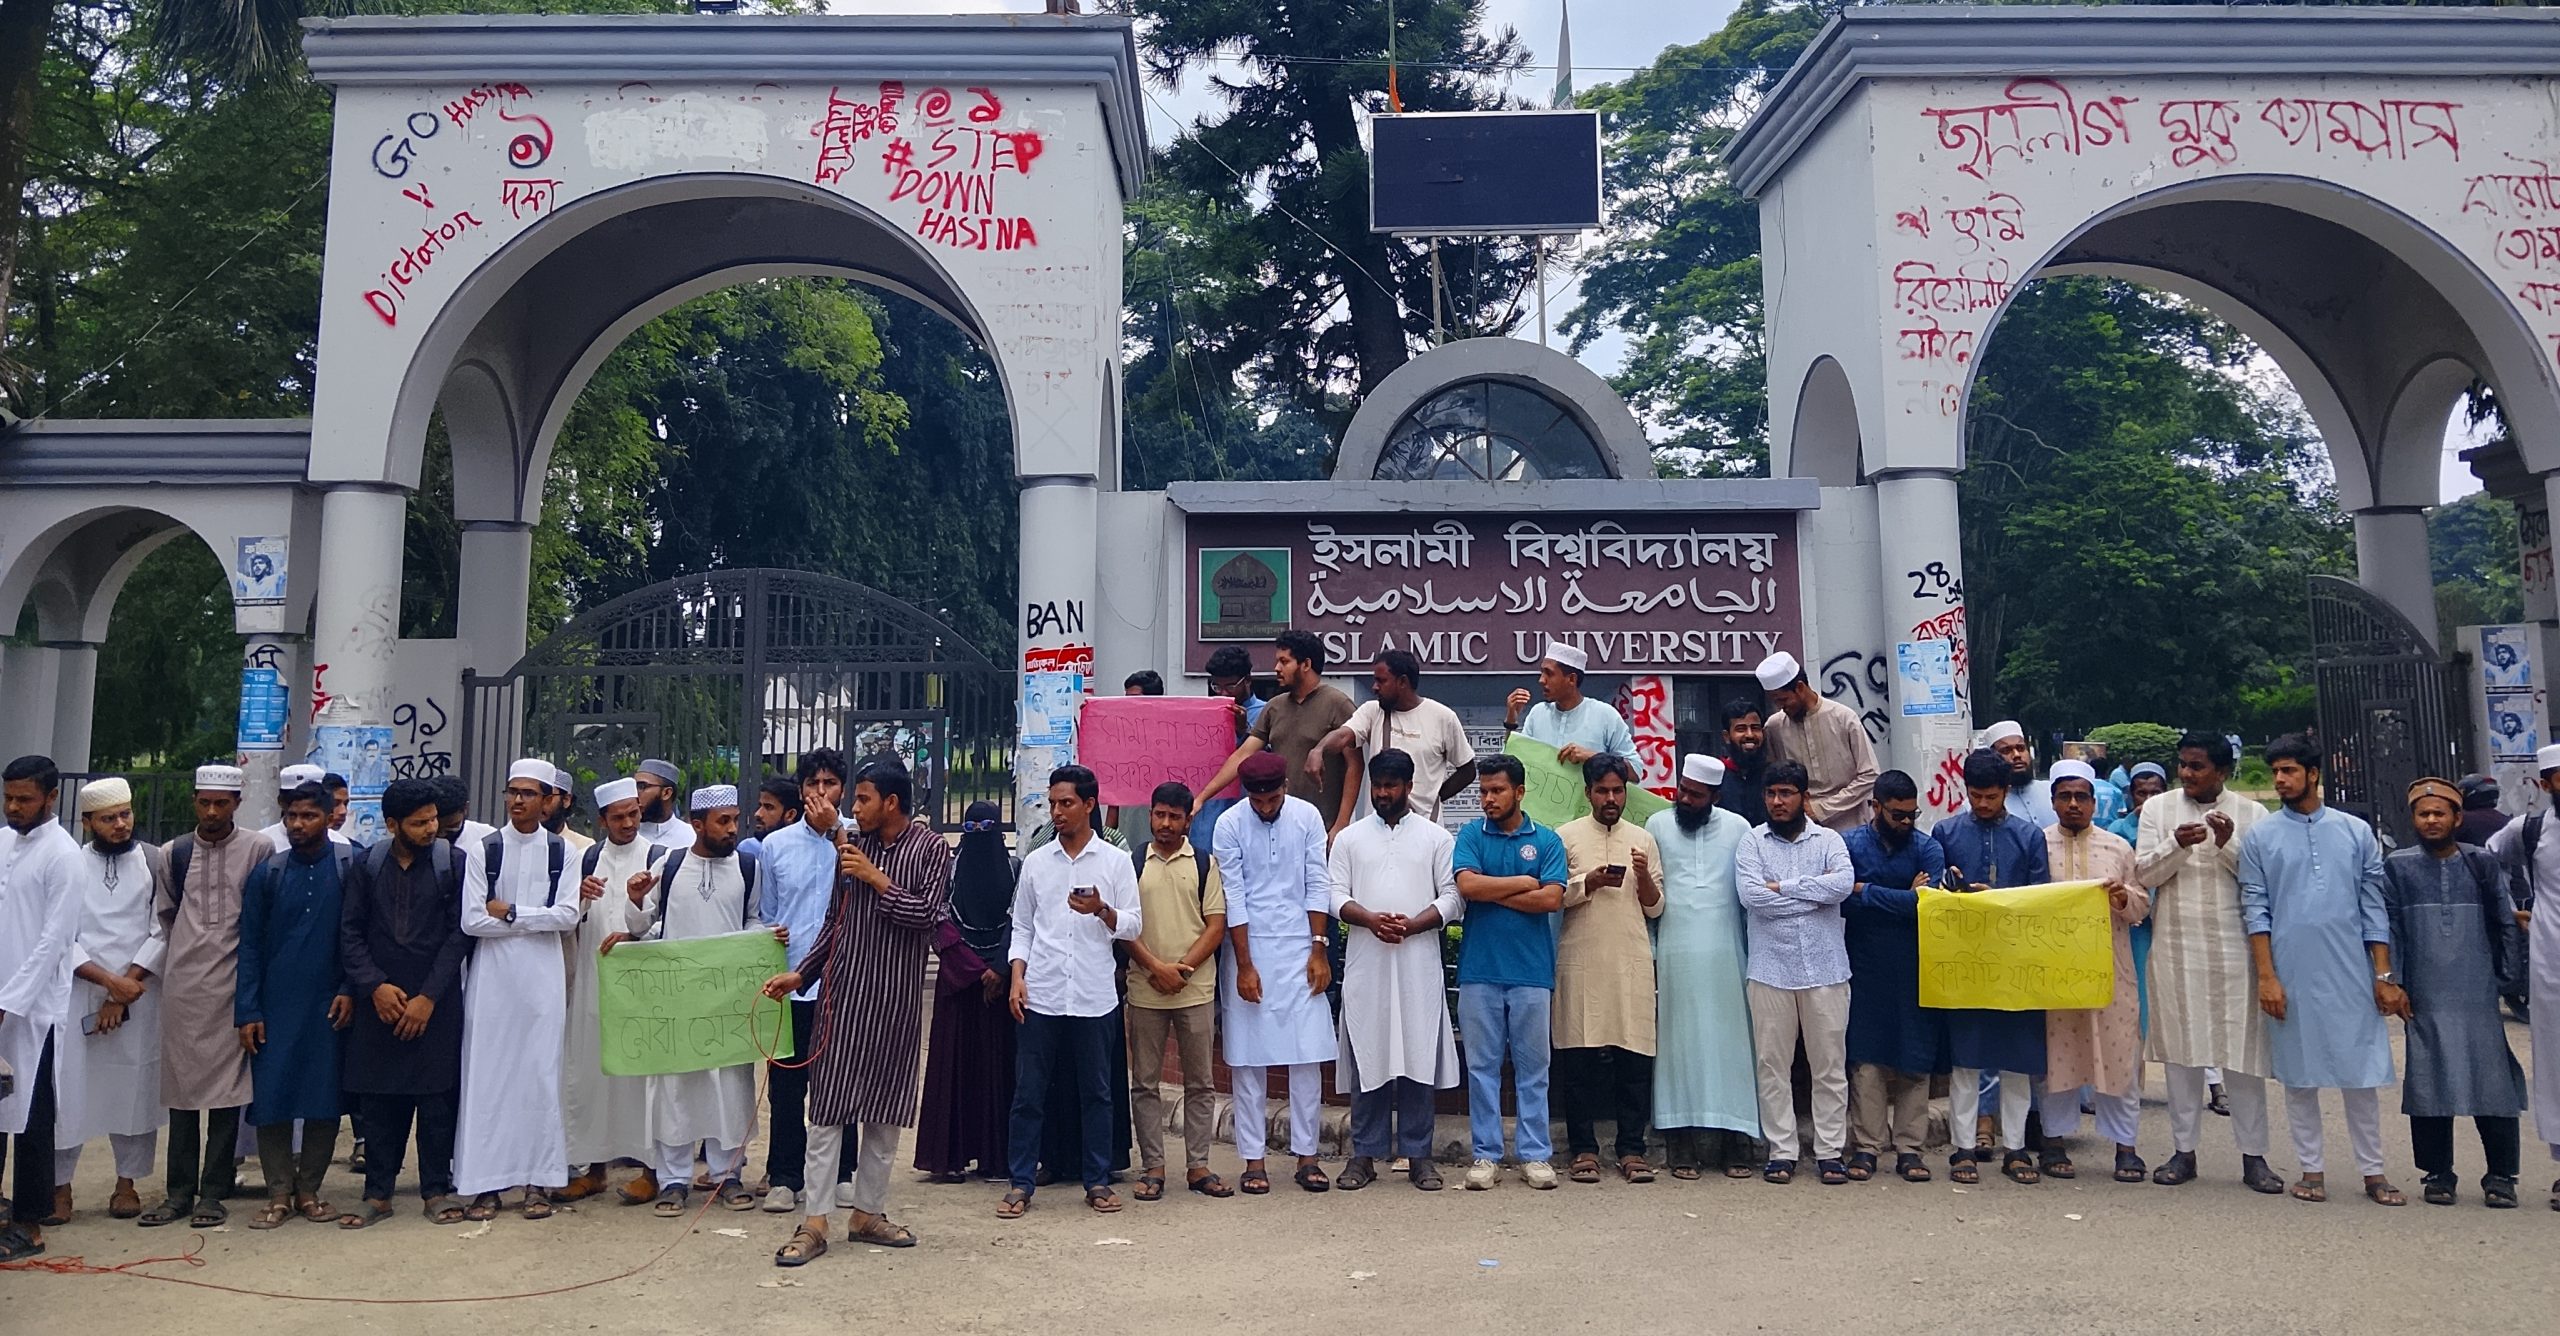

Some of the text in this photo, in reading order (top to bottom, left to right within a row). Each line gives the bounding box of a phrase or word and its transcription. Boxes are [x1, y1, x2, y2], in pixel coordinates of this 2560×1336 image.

[372, 112, 439, 178] GO
[888, 169, 996, 216] DOWN
[1307, 520, 1778, 572] ইসলামী বিশ্ববিদ্যালয়
[1026, 599, 1085, 639] BAN
[1561, 568, 1778, 625] الجامعة
[1312, 631, 1489, 664] SLAMIC
[393, 697, 447, 745] ৭১
